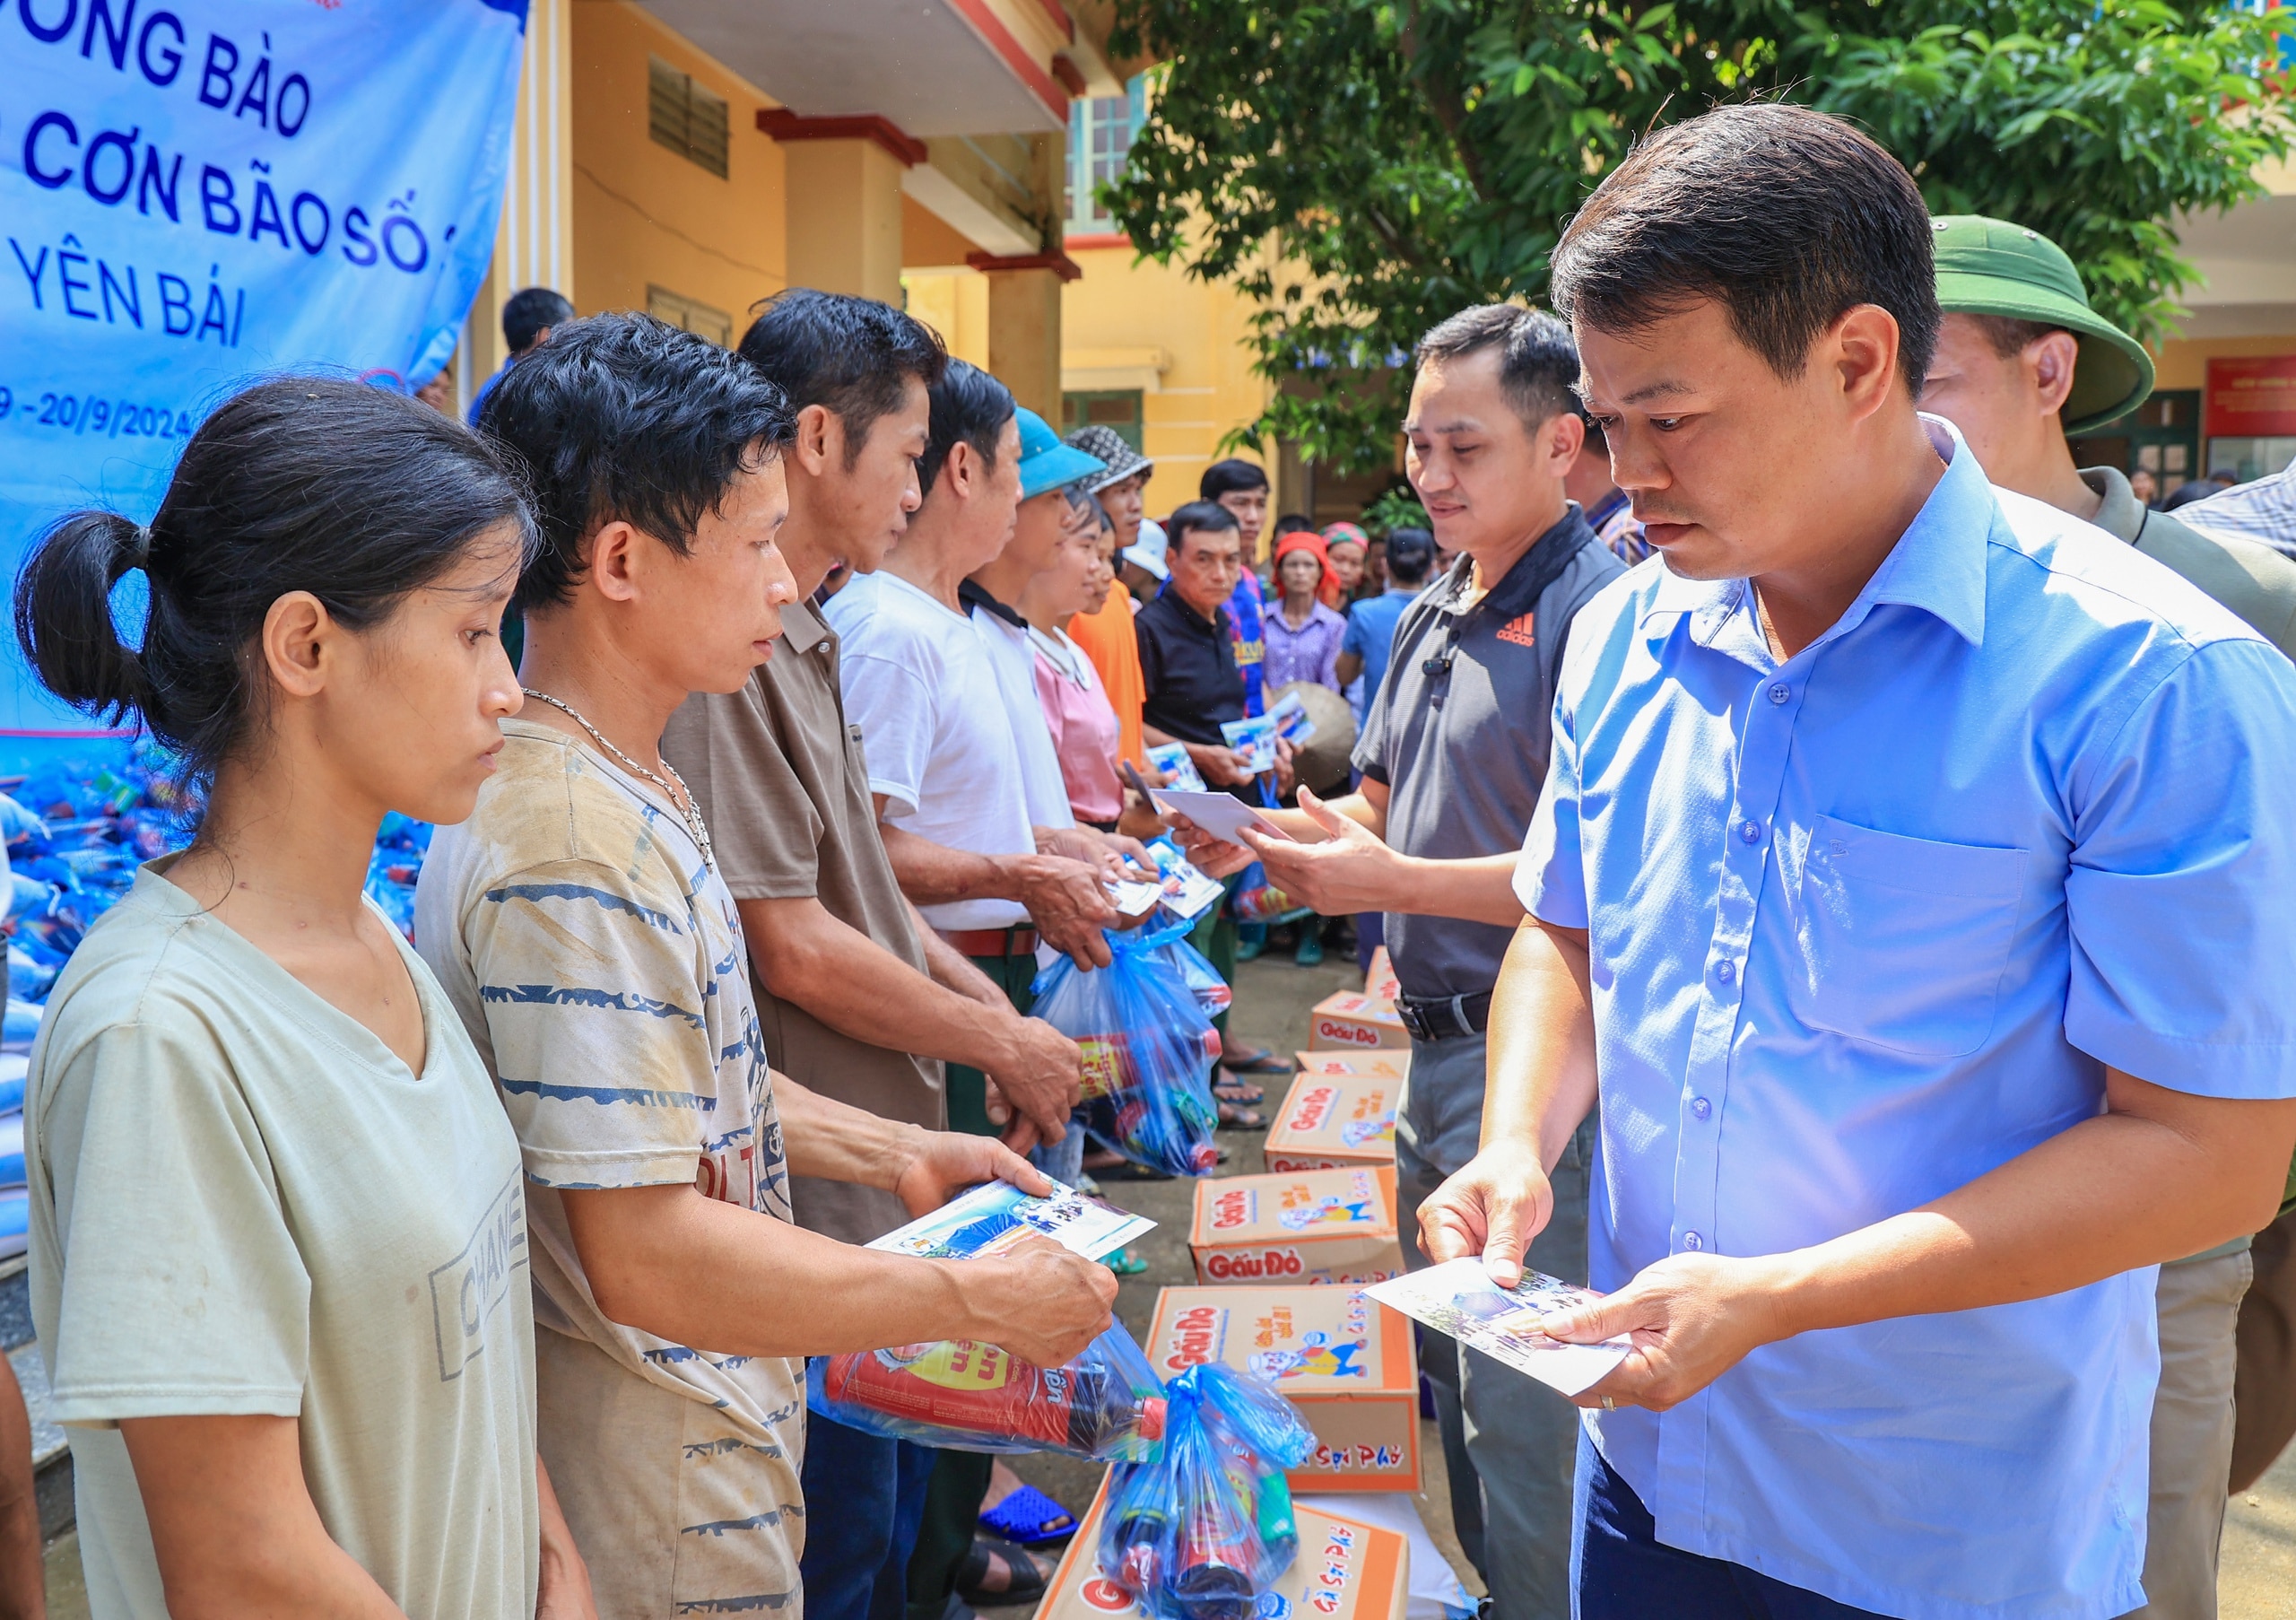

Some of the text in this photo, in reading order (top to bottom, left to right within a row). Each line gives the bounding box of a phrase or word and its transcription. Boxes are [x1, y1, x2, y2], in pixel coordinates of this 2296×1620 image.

[199, 32, 310, 138] BÀO
[23, 109, 185, 223] CƠN
[200, 159, 330, 256] BÃO
[341, 189, 429, 274] SỐ
[9, 232, 247, 349] YÊN BÁI
[1496, 629, 1535, 647] adidas
[1208, 1253, 1263, 1278] Gấu
[977, 1345, 1000, 1380] on
[1042, 1368, 1068, 1404] iền
[1316, 1445, 1349, 1469] Sợi
[1356, 1443, 1404, 1466] Phở
[1313, 1590, 1340, 1613] Gà
